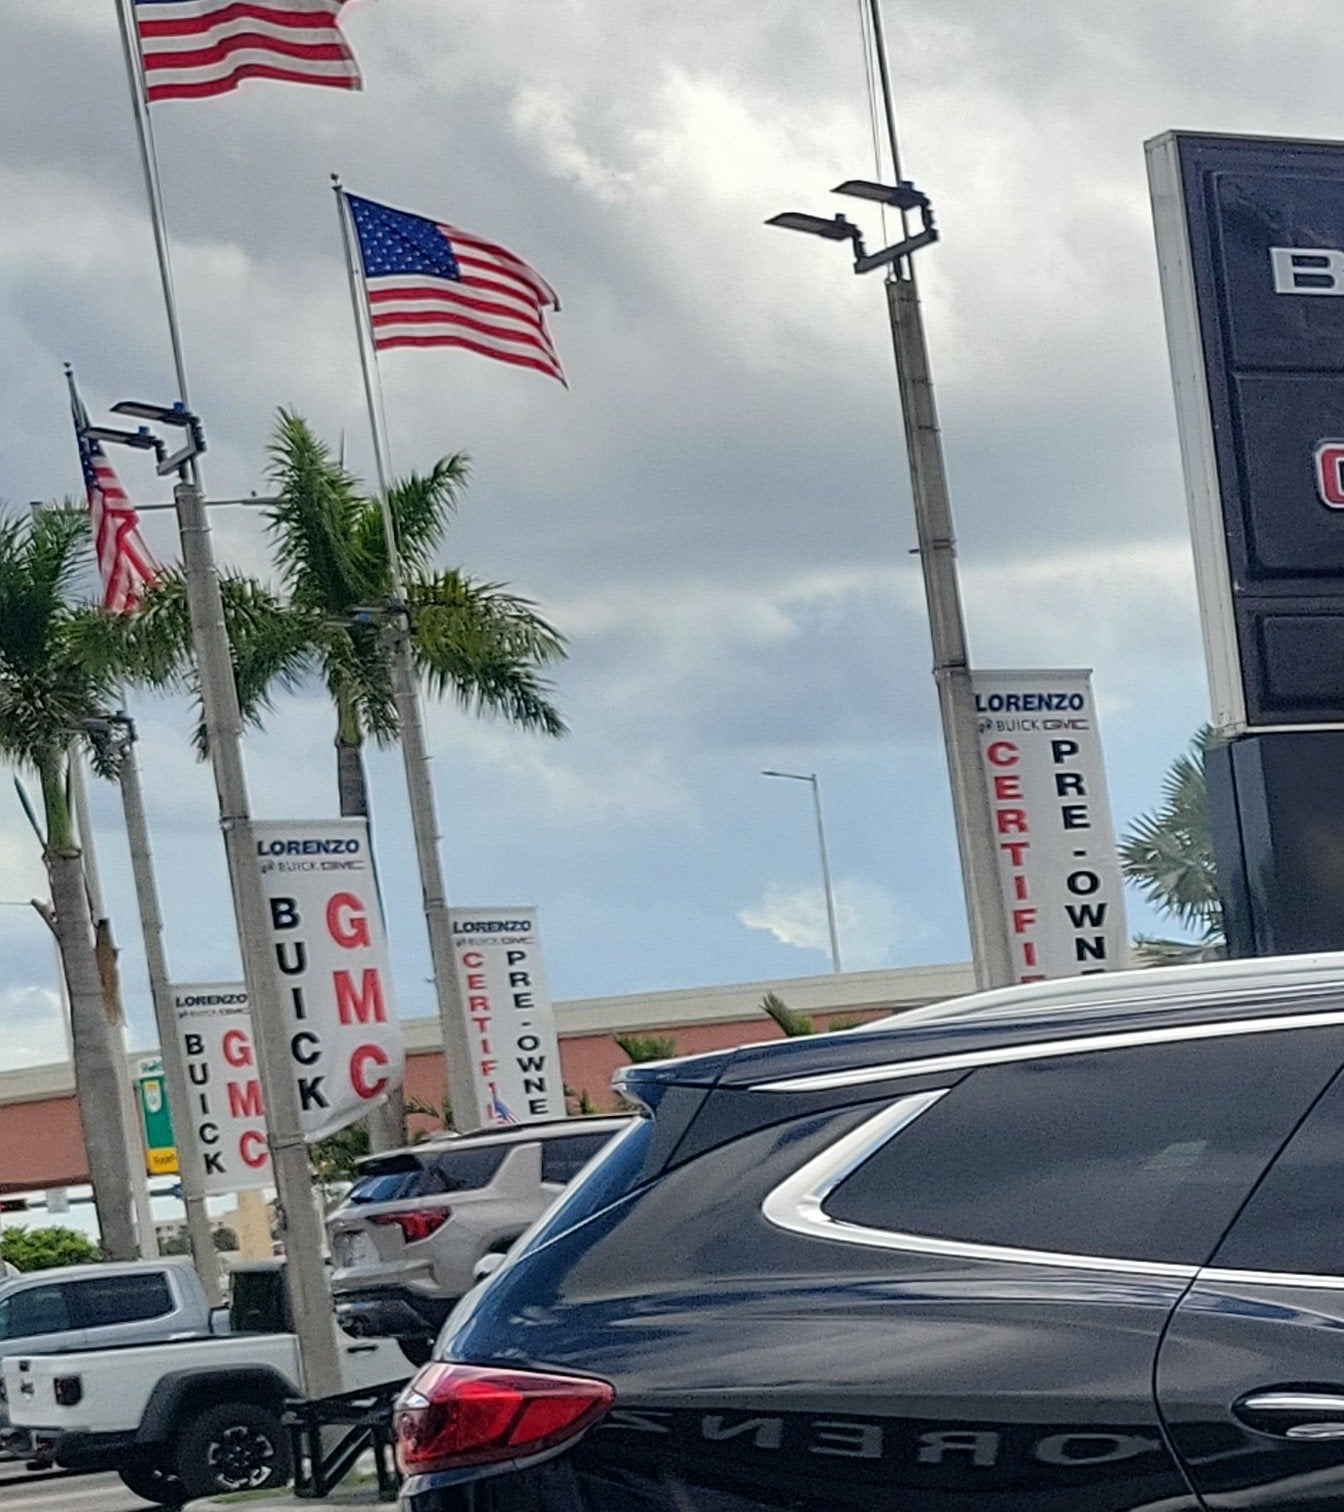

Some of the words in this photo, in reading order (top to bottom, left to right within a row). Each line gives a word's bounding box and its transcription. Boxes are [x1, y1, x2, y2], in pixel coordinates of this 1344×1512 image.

[975, 693, 1084, 712] LORENZO
[996, 719, 1040, 732] BUICK
[257, 838, 360, 857] LORENZO
[986, 740, 1046, 984] CERTIFI
[1050, 739, 1108, 976] PRE-OWN
[325, 891, 389, 1100] GMC
[453, 920, 531, 934] LORENZO
[269, 896, 330, 1112] BUICK
[506, 950, 549, 1115] PRE-OWNE
[184, 1033, 227, 1176] BUICK
[221, 1028, 269, 1169] GMC
